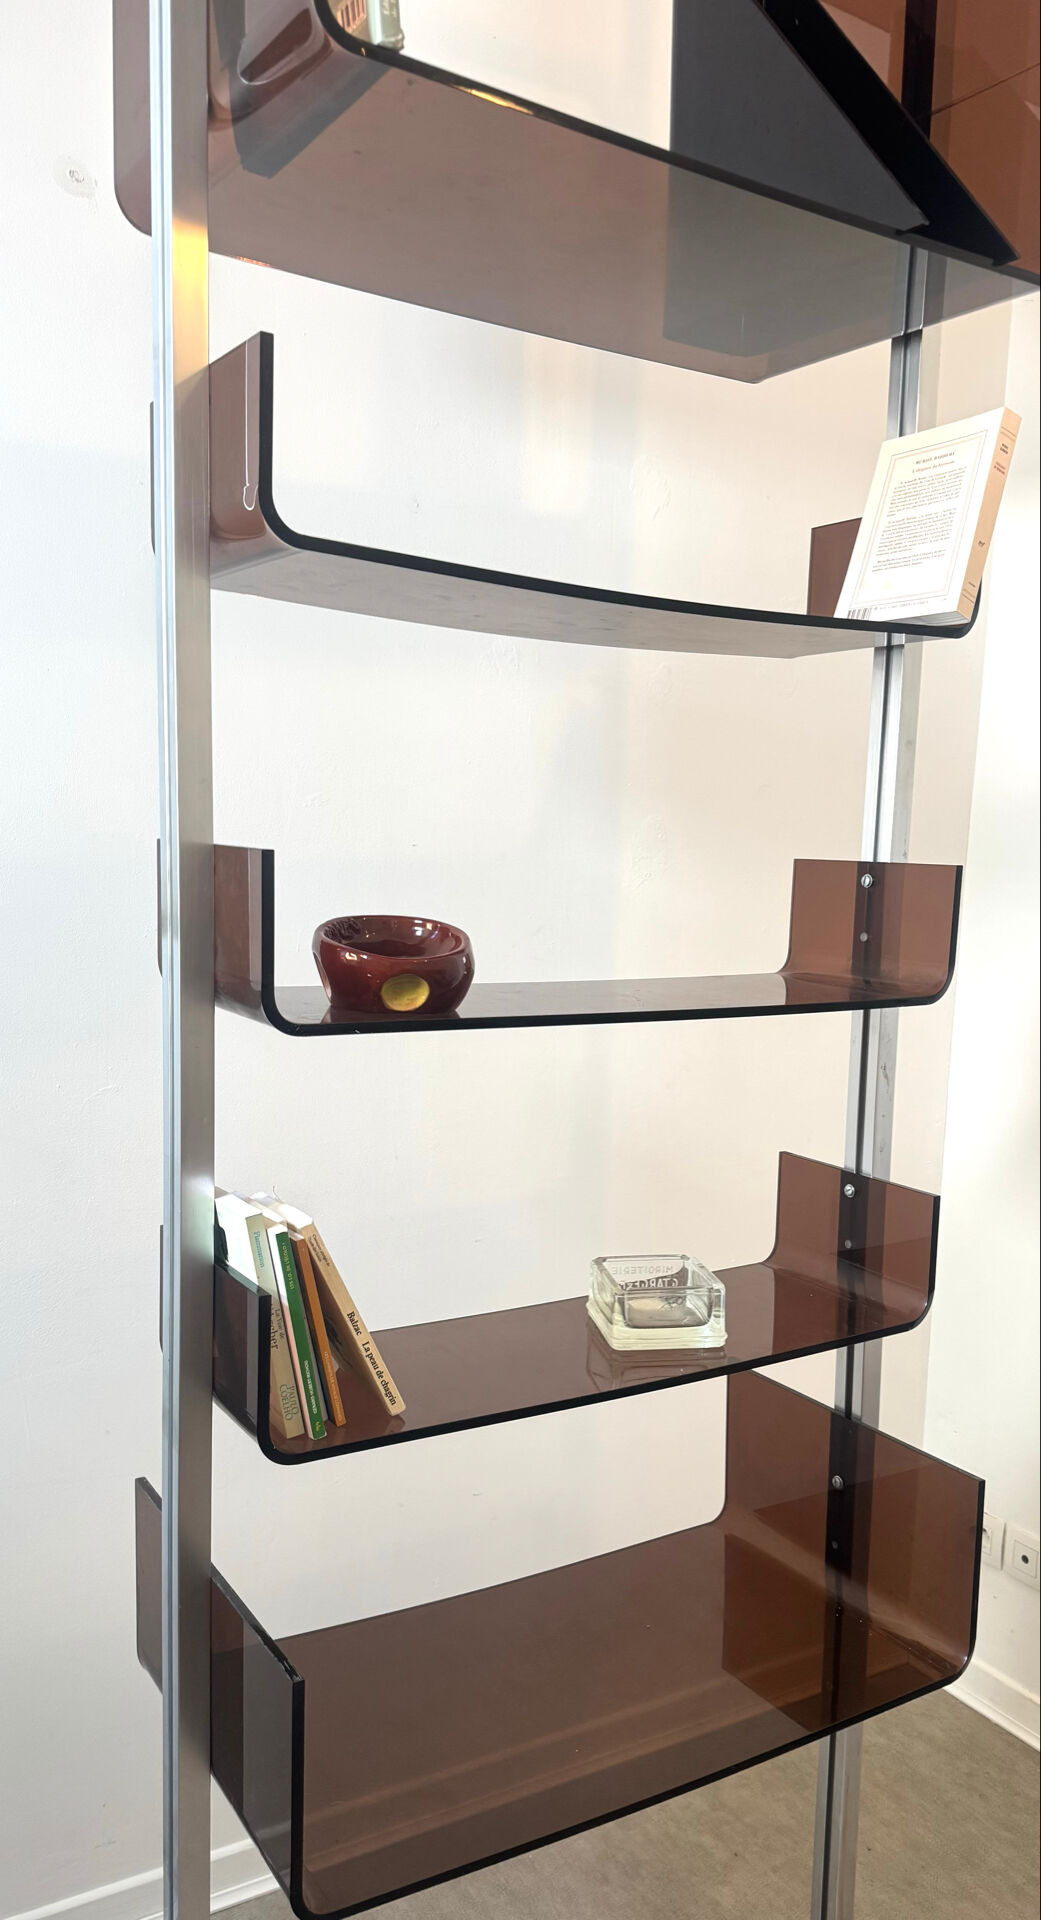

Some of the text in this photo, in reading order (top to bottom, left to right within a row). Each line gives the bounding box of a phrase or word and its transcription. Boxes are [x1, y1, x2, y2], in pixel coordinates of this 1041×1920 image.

[346, 1311, 397, 1406] Balzac La peau de chagrin
[280, 1384, 293, 1421] COELHO
[287, 1385, 300, 1415] PAULO
